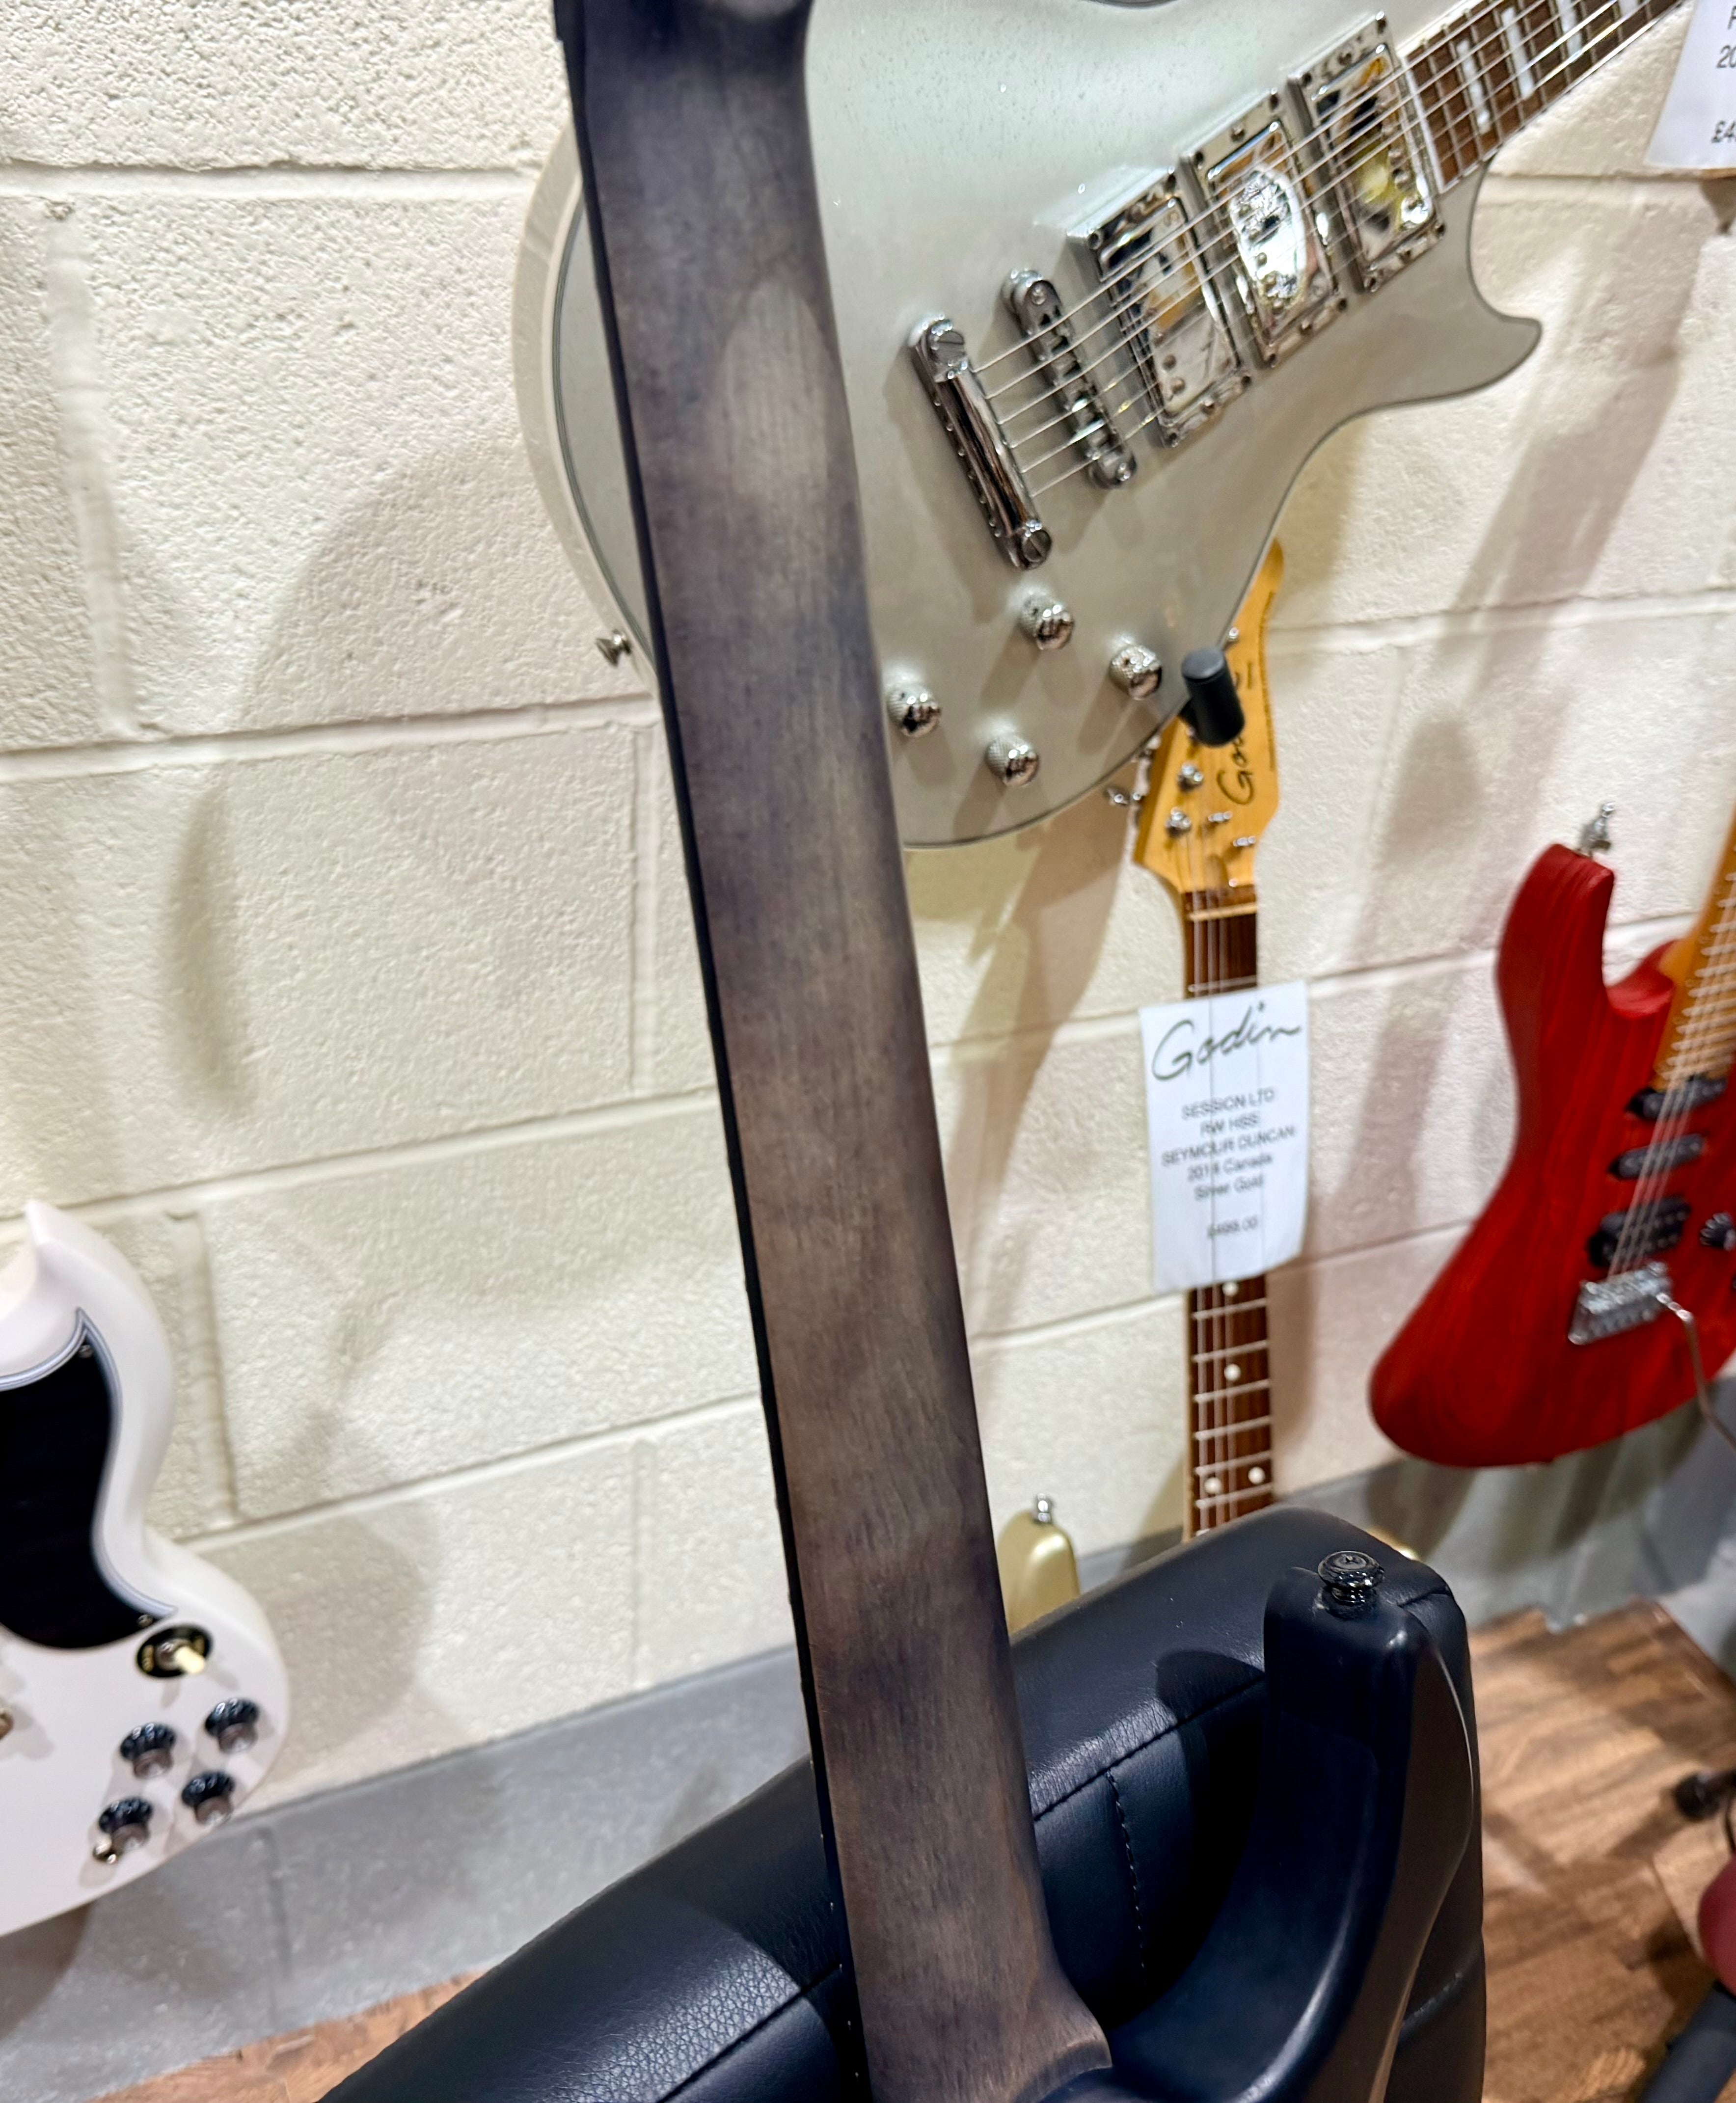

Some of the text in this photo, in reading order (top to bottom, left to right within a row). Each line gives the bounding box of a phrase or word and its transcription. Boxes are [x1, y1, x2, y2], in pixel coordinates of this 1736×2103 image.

[1151, 1000, 1302, 1081] Godin
[1182, 1086, 1275, 1120] SESSION LTD
[1229, 1110, 1260, 1132] HSS
[1162, 1125, 1296, 1166] SEYMOUR DUNCAN
[1223, 1153, 1273, 1174] Canada
[1234, 1174, 1264, 1193] Gold
